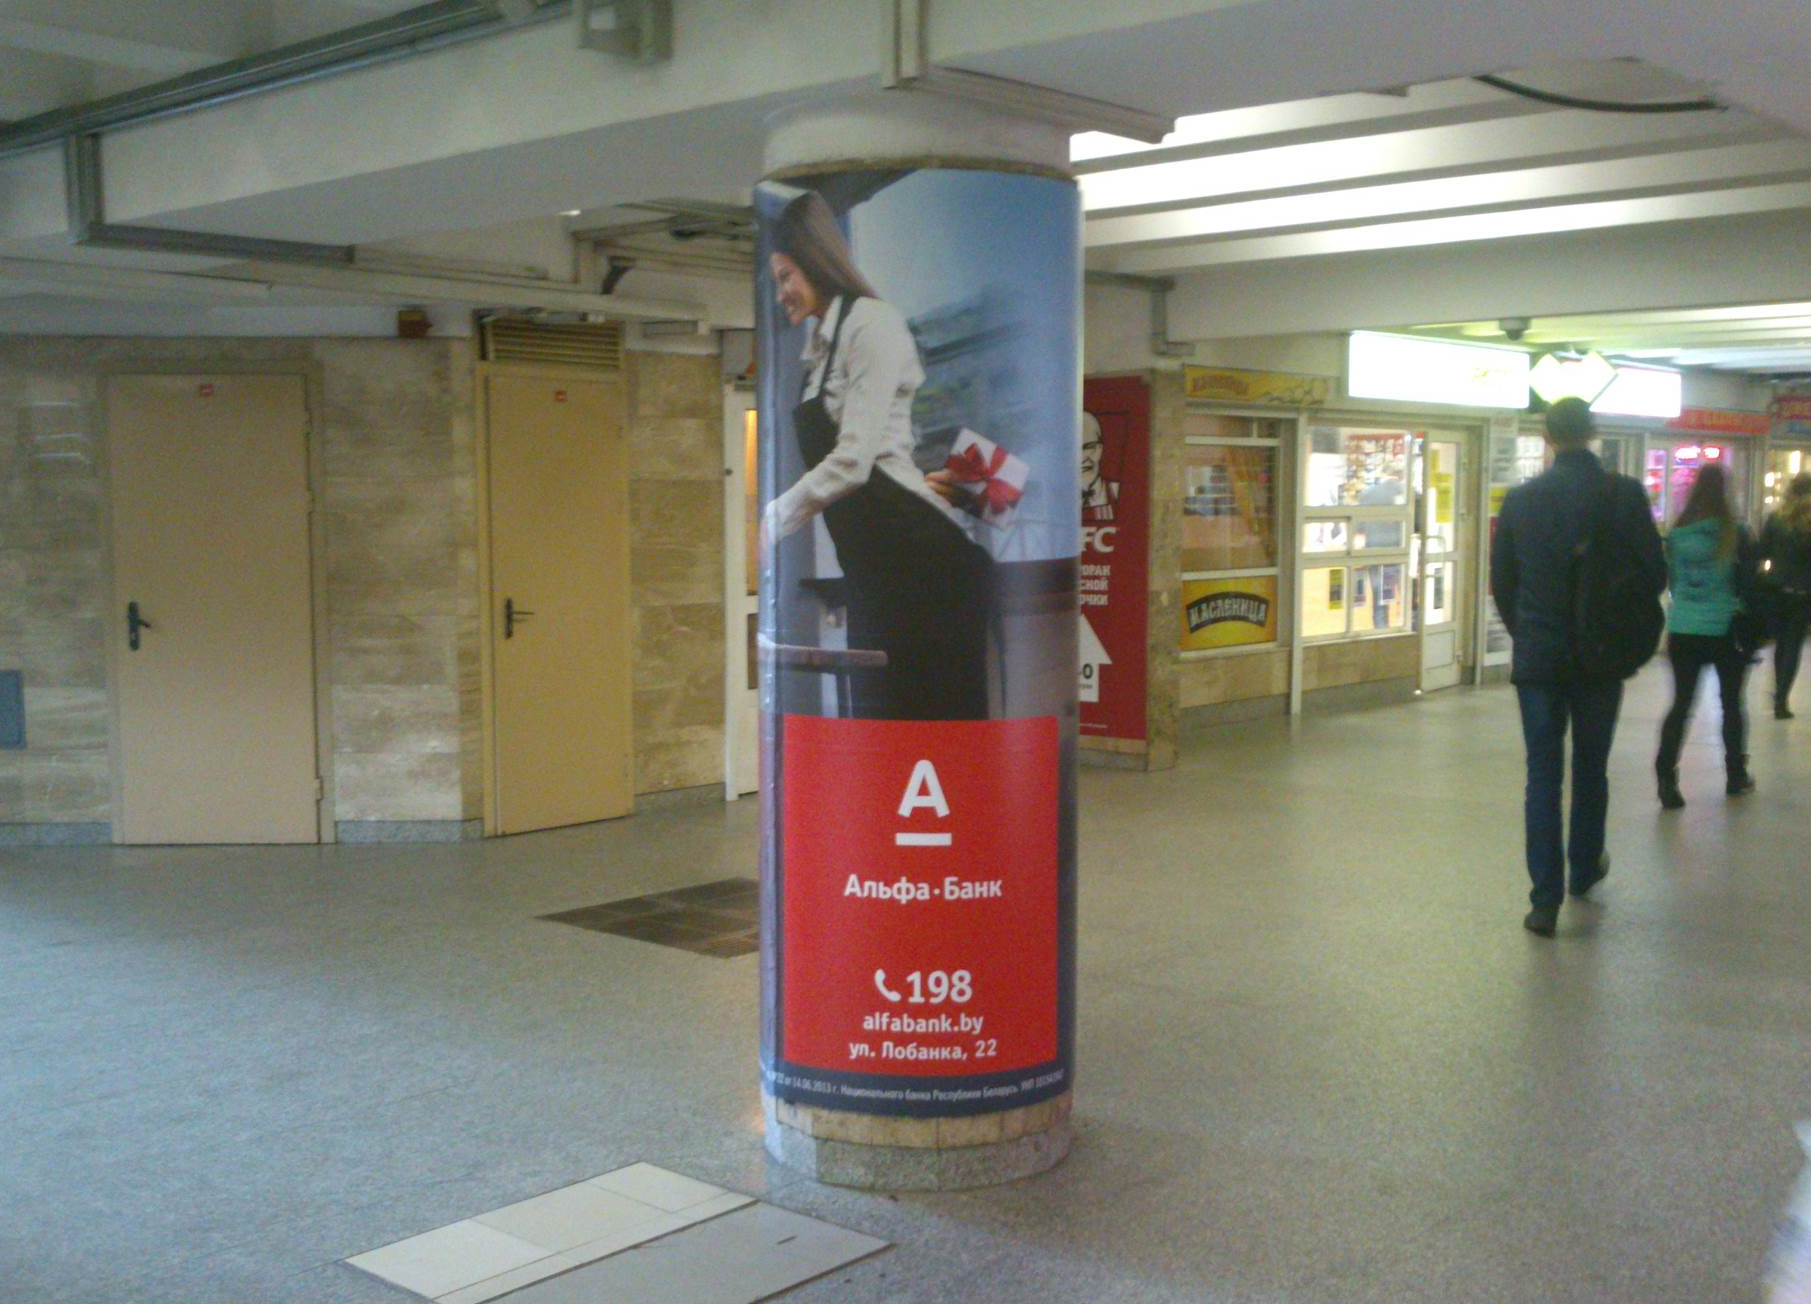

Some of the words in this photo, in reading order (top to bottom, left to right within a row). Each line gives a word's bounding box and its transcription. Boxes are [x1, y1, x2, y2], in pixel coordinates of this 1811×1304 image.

[906, 969, 973, 1004] 198
[863, 1012, 984, 1034] alfabank.by
[849, 1042, 876, 1059] ул.
[882, 1041, 968, 1060] Лобанка,
[975, 1039, 998, 1057] 22
